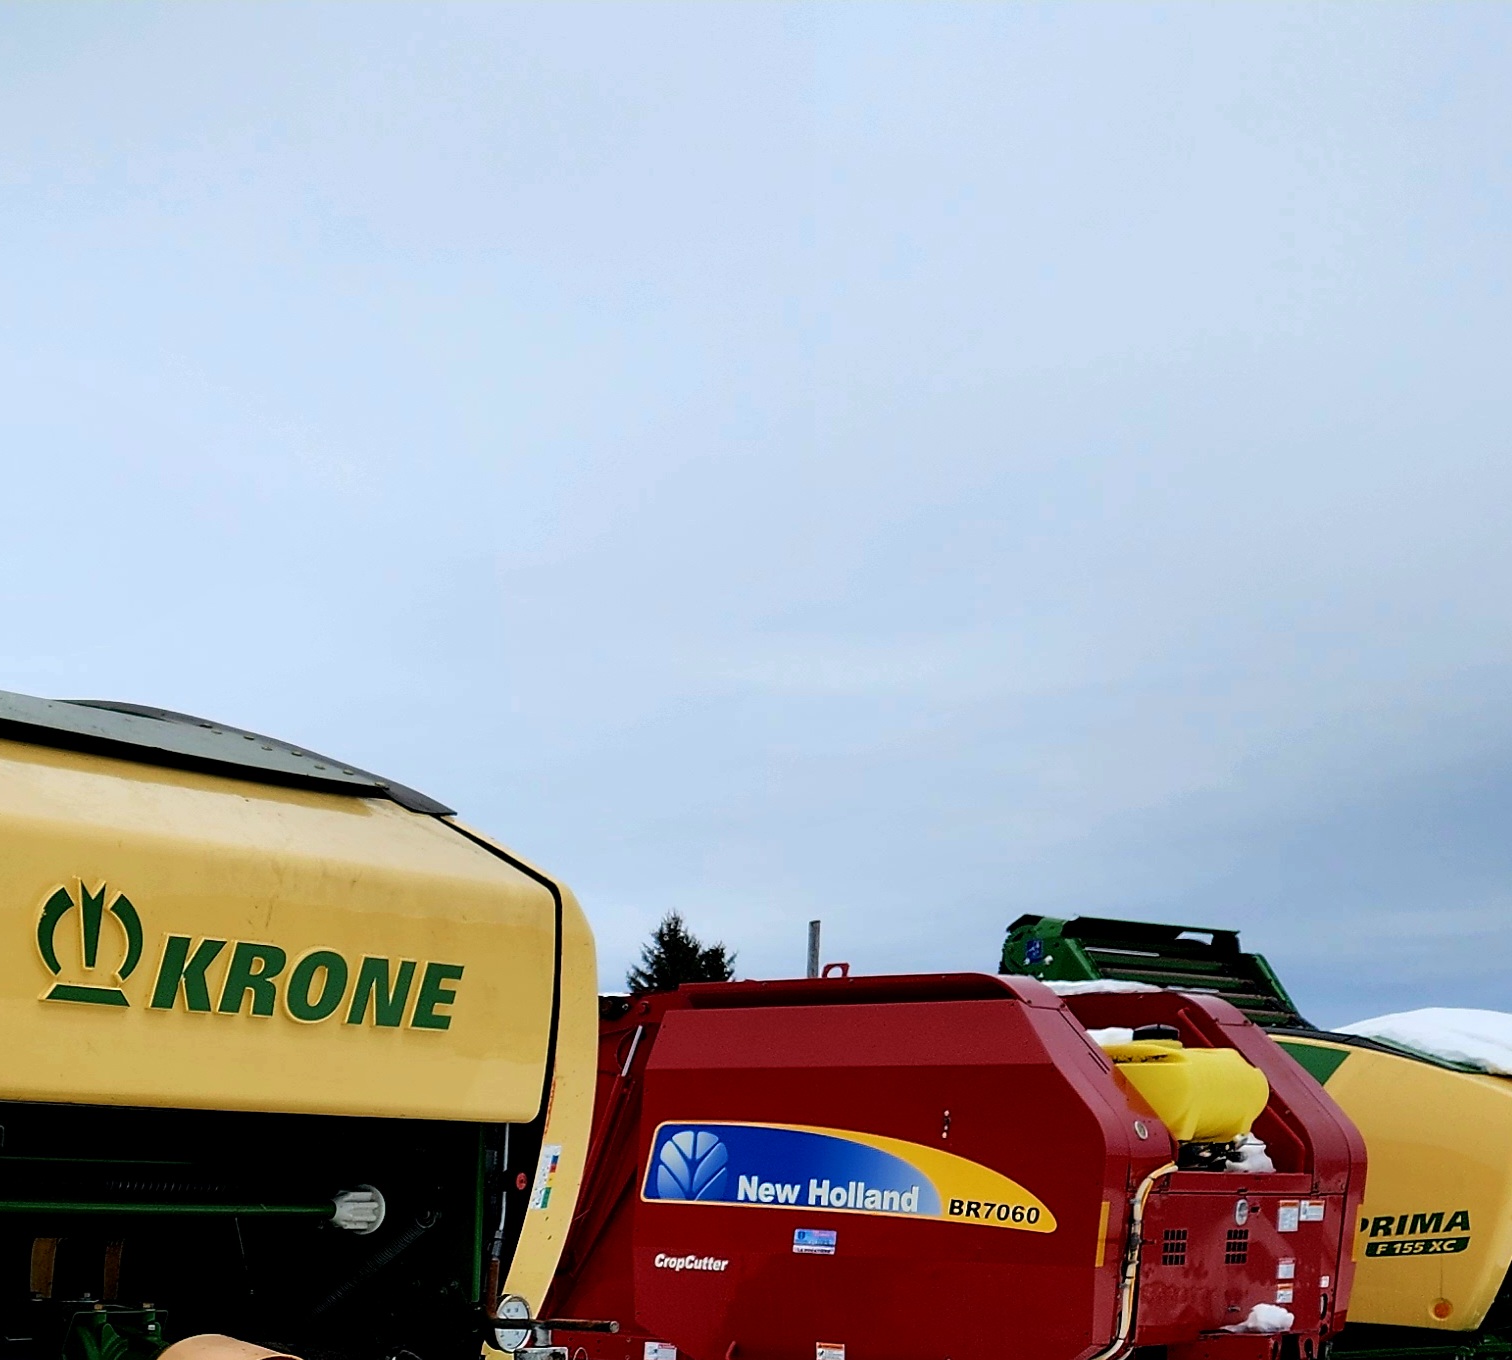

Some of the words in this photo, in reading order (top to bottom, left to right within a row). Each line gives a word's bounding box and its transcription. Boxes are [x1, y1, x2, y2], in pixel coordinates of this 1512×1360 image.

[148, 933, 465, 1031] KRONE
[737, 1174, 800, 1205] New
[807, 1178, 919, 1213] Holland
[948, 1198, 1040, 1225] BR7060
[1376, 1244, 1388, 1255] F
[1393, 1241, 1426, 1254] 155
[1429, 1239, 1457, 1253] XC
[654, 1252, 729, 1272] CropCutter
